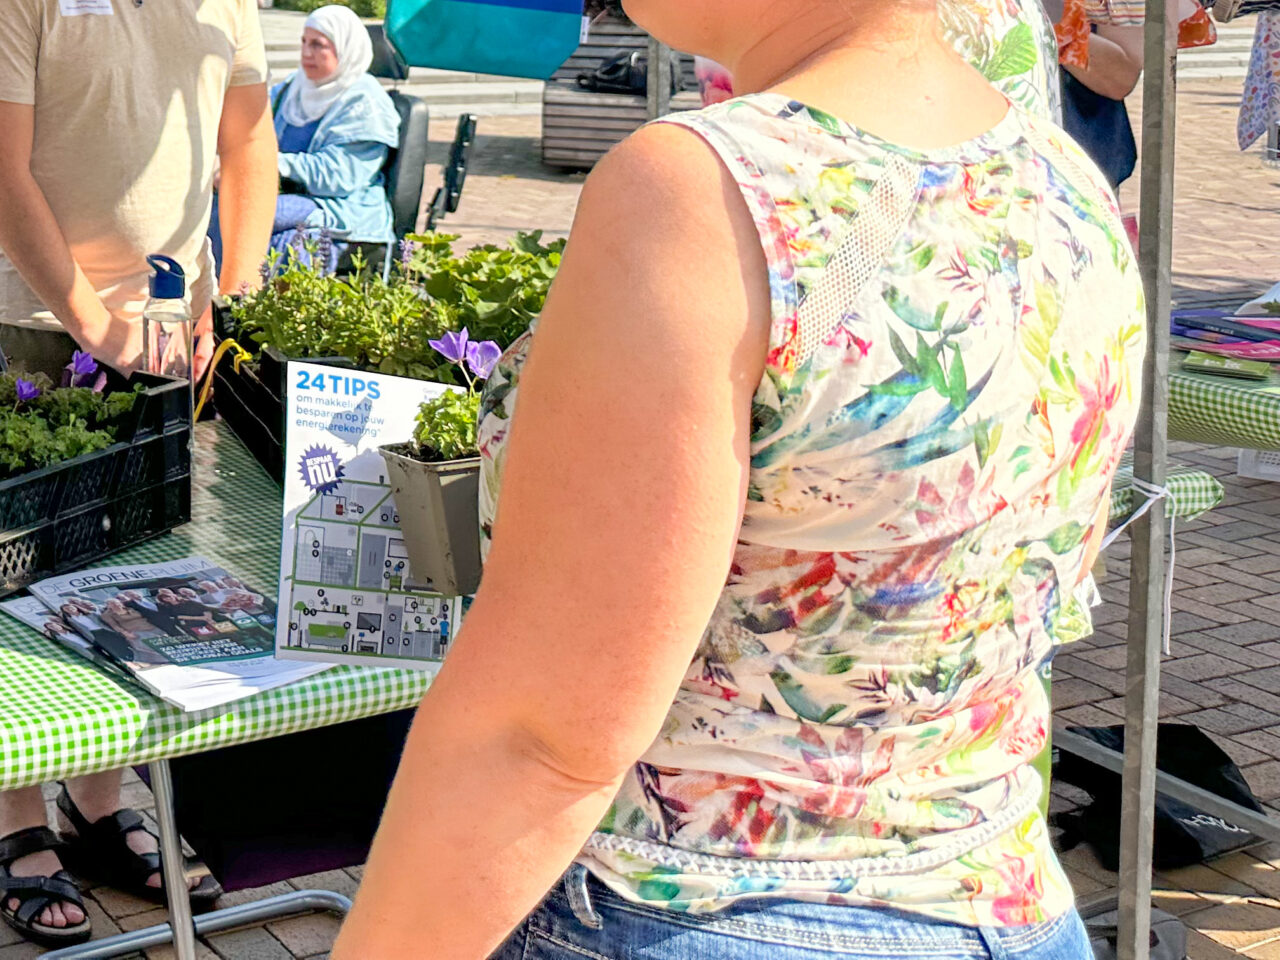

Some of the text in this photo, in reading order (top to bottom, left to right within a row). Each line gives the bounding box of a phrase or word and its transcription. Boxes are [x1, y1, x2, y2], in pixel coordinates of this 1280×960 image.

[296, 394, 313, 403] om
[345, 412, 359, 423] op
[361, 413, 385, 425] jouw
[69, 568, 150, 589] GROENE
